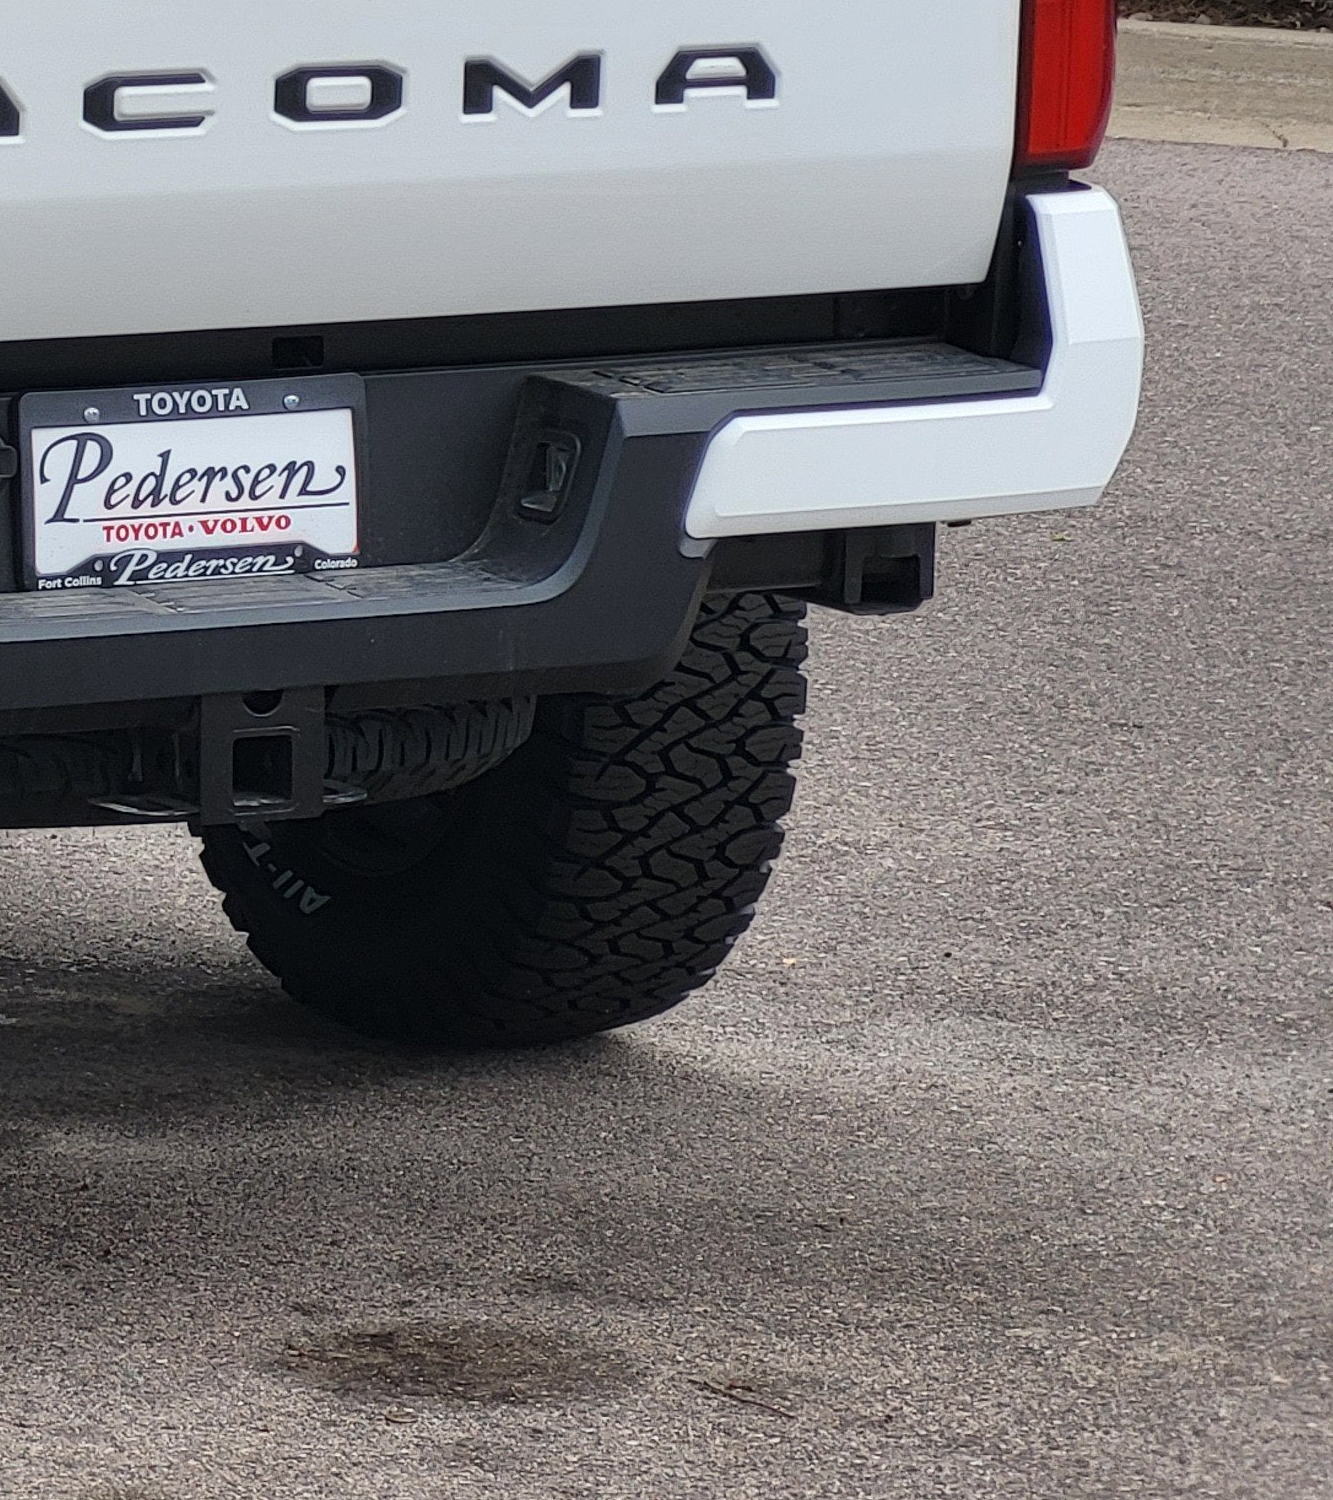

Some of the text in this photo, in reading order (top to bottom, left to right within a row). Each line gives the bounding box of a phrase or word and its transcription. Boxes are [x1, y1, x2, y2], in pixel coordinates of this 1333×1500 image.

[133, 387, 249, 416] TOYOTA
[39, 432, 347, 526] Pedersen
[102, 514, 292, 543] TOYOTA VOLVO
[109, 548, 295, 587] Pedersen
[314, 557, 359, 570] Colorado
[38, 575, 102, 590] Fort Collins
